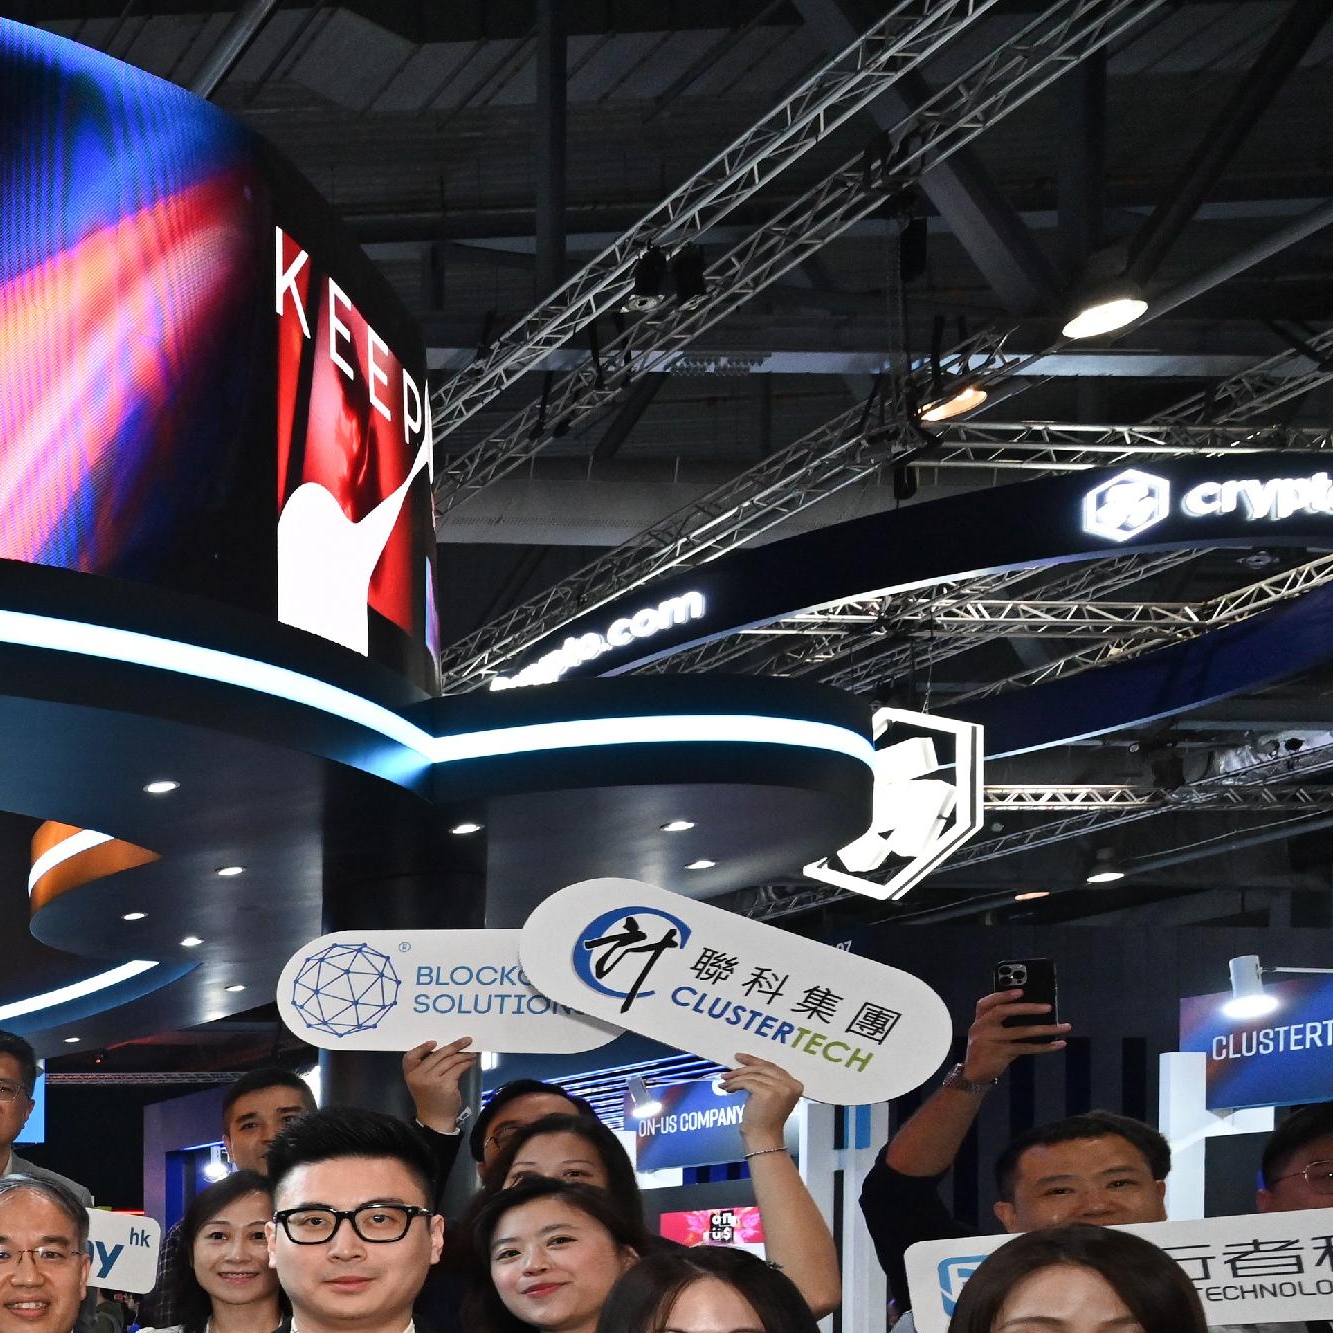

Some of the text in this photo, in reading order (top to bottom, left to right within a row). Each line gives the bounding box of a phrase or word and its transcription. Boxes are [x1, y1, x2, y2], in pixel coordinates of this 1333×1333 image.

[276, 225, 423, 444] KEEP
[413, 993, 584, 1015] SOLUTION
[690, 947, 902, 1045] 聯科集團
[670, 985, 875, 1073] CLUSTERTECH
[679, 1104, 746, 1132] COMPANY
[129, 1226, 151, 1249] hk
